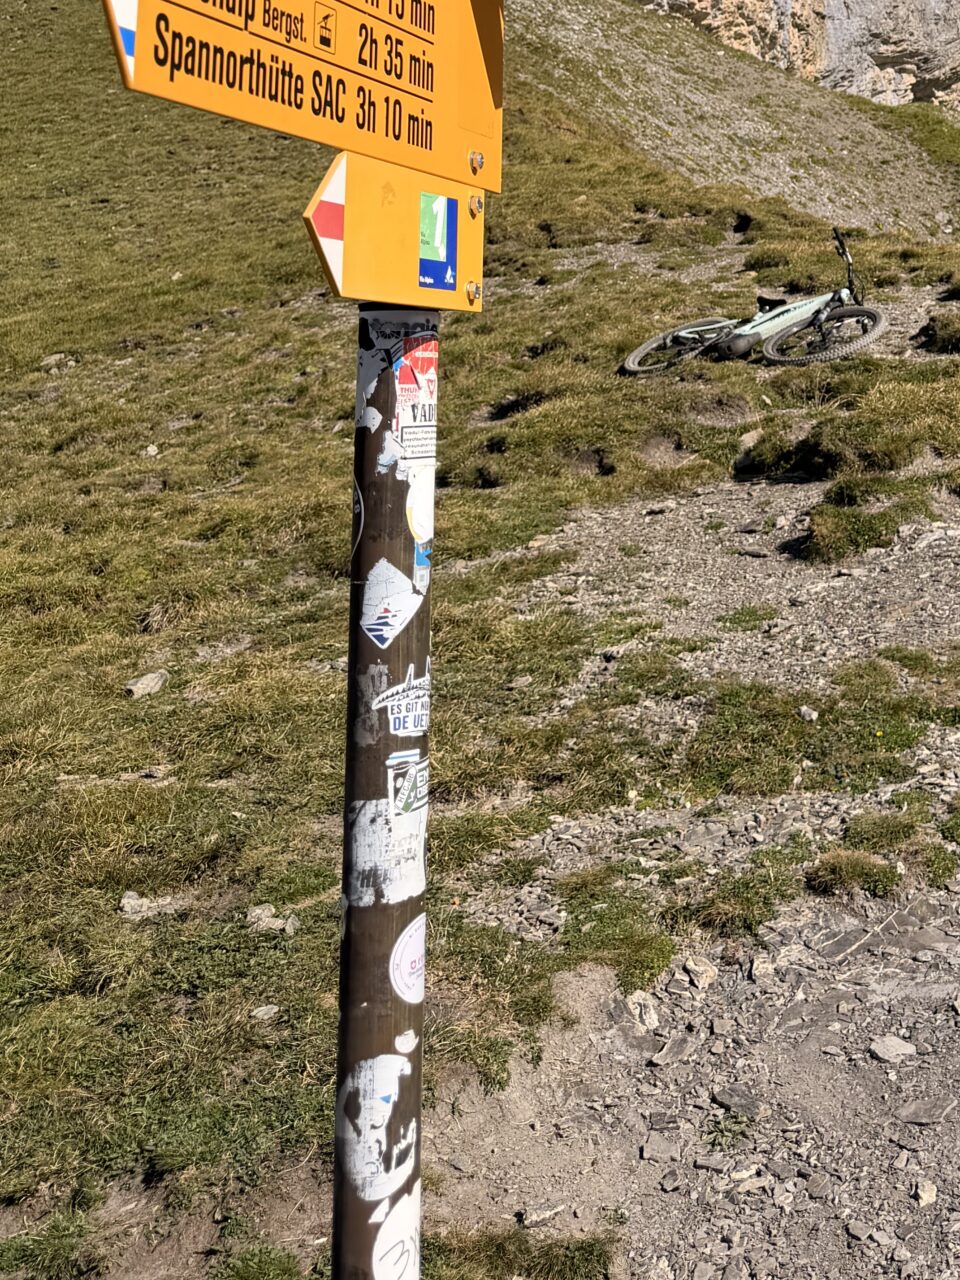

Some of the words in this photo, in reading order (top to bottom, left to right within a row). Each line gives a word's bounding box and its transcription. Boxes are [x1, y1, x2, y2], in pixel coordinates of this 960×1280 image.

[358, 24, 377, 69] 2h
[385, 35, 403, 79] 35
[409, 50, 433, 92] min
[154, 13, 304, 110] Spannorthütte
[312, 71, 345, 123] SAC
[357, 86, 375, 132] 3h
[385, 97, 401, 140] 10
[408, 110, 432, 150] min
[391, 703, 402, 715] ES
[406, 701, 419, 714] GIT
[393, 715, 409, 731] DE
